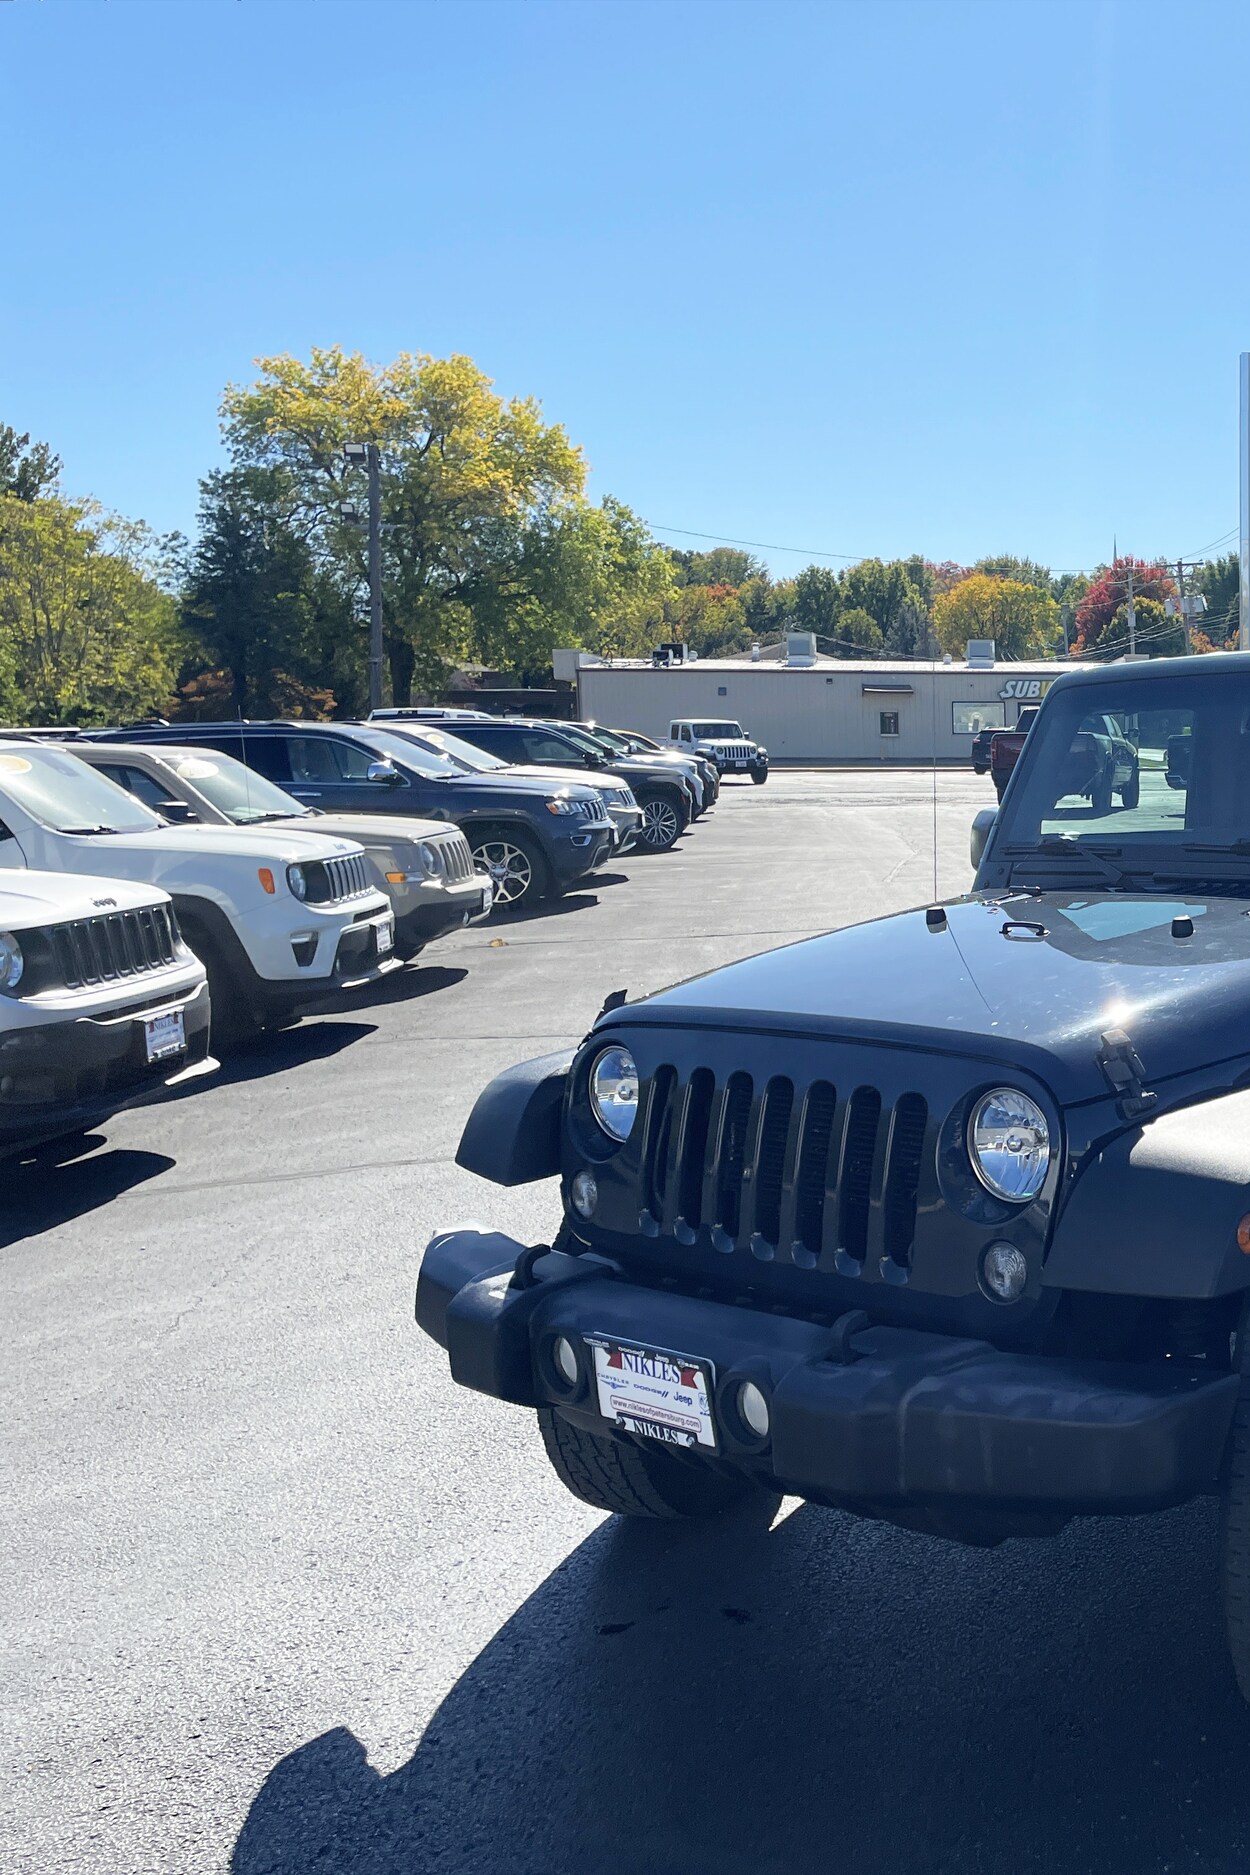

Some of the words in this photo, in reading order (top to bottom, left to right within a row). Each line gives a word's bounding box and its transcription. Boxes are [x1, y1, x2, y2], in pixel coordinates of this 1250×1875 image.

[621, 1352, 681, 1384] NIKLES
[597, 1372, 630, 1385] CHRYSLER
[673, 1391, 693, 1407] Jeep
[612, 1398, 700, 1428] www.niklesofpetersburg.com
[634, 1421, 678, 1445] NIKLES
